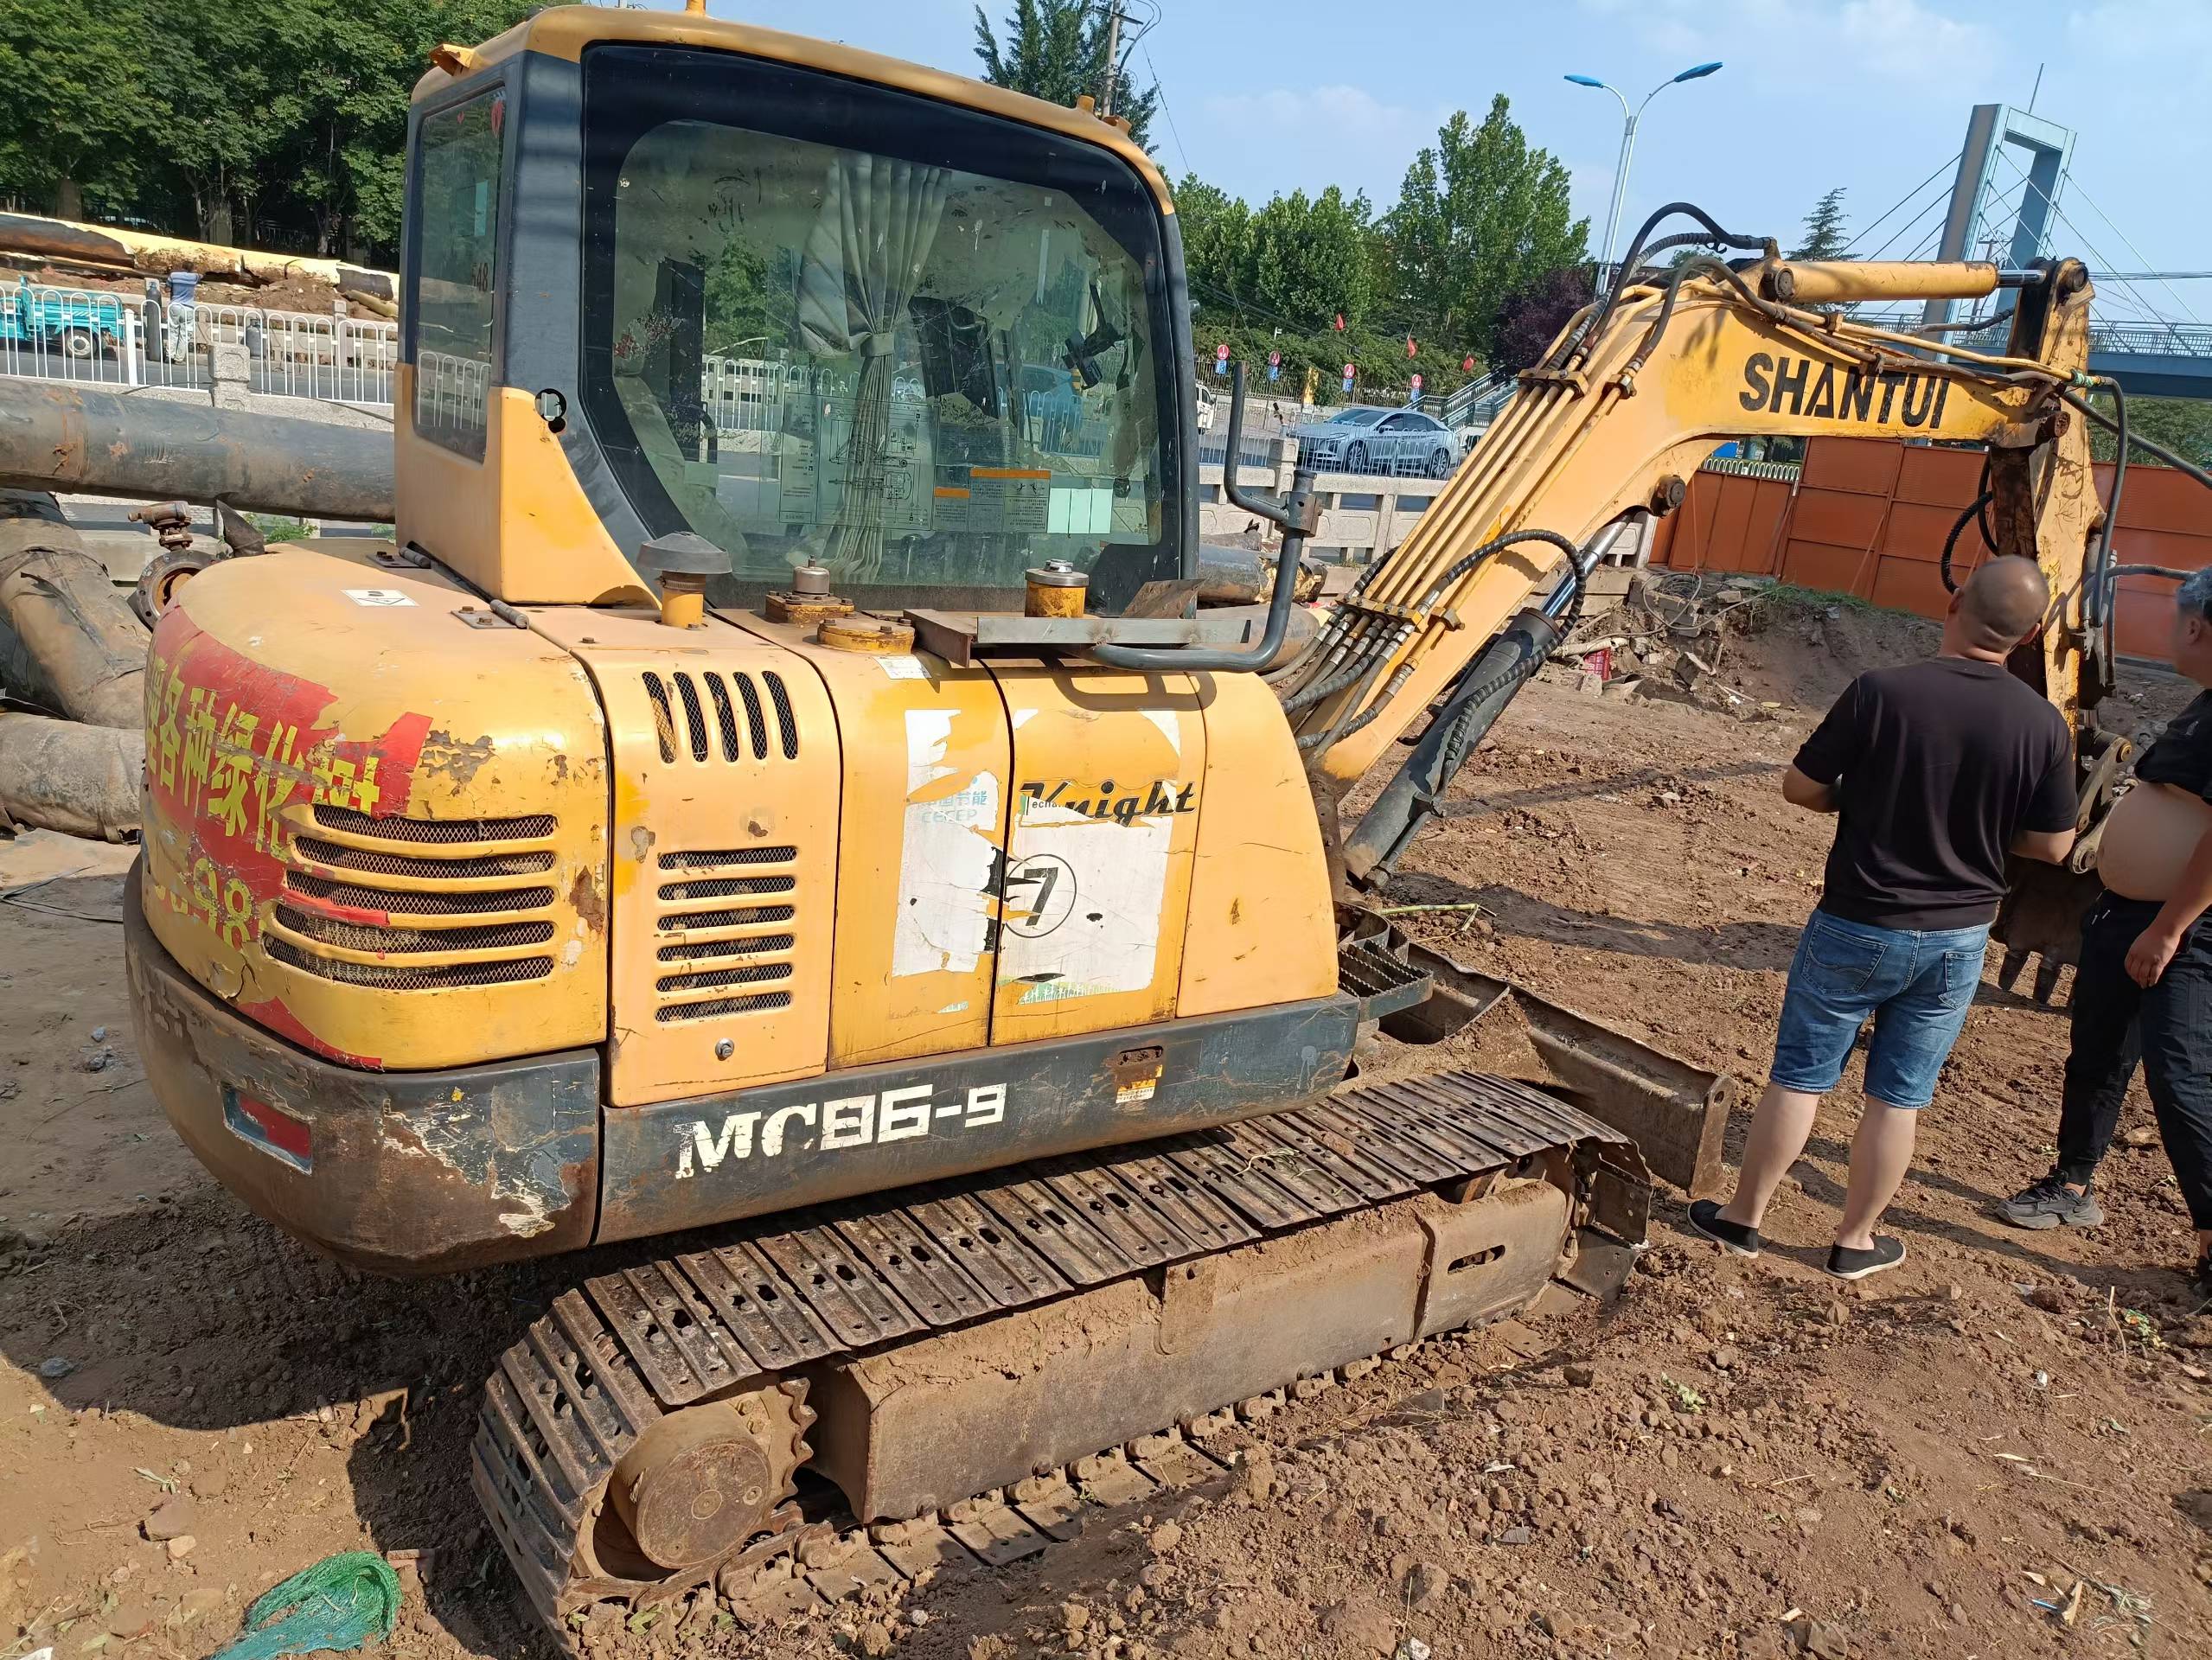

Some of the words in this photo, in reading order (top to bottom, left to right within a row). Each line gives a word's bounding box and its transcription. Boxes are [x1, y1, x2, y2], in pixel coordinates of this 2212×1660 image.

[1738, 352, 1951, 430] SHANTUI
[925, 790, 988, 807] 国节能
[1023, 866, 1059, 927] 7
[673, 1082, 1007, 1180] MC86-9
